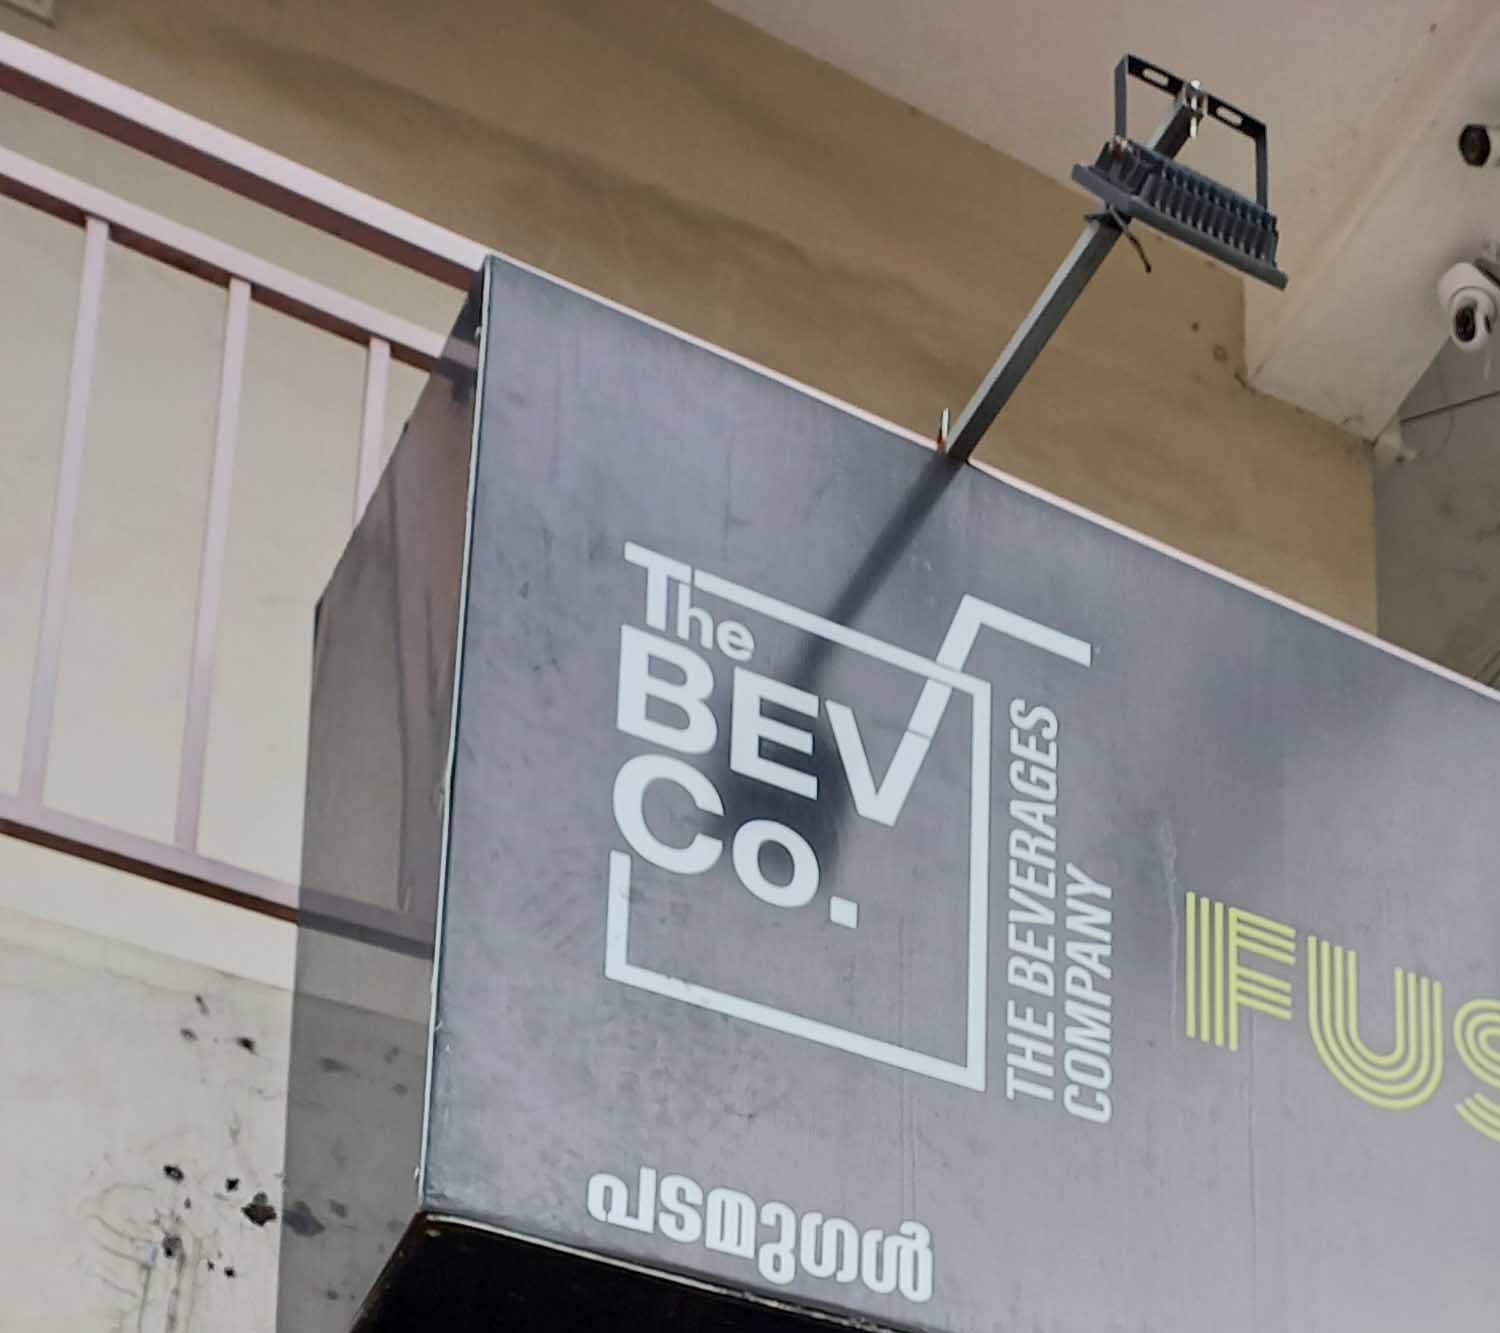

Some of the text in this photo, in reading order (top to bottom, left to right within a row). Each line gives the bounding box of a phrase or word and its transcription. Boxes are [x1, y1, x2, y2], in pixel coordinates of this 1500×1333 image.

[624, 541, 755, 662] The
[616, 625, 952, 827] BEV
[612, 753, 858, 929] Co.
[1006, 698, 1059, 1101] THE BEVERAGES
[1062, 862, 1113, 1124] COMPANY
